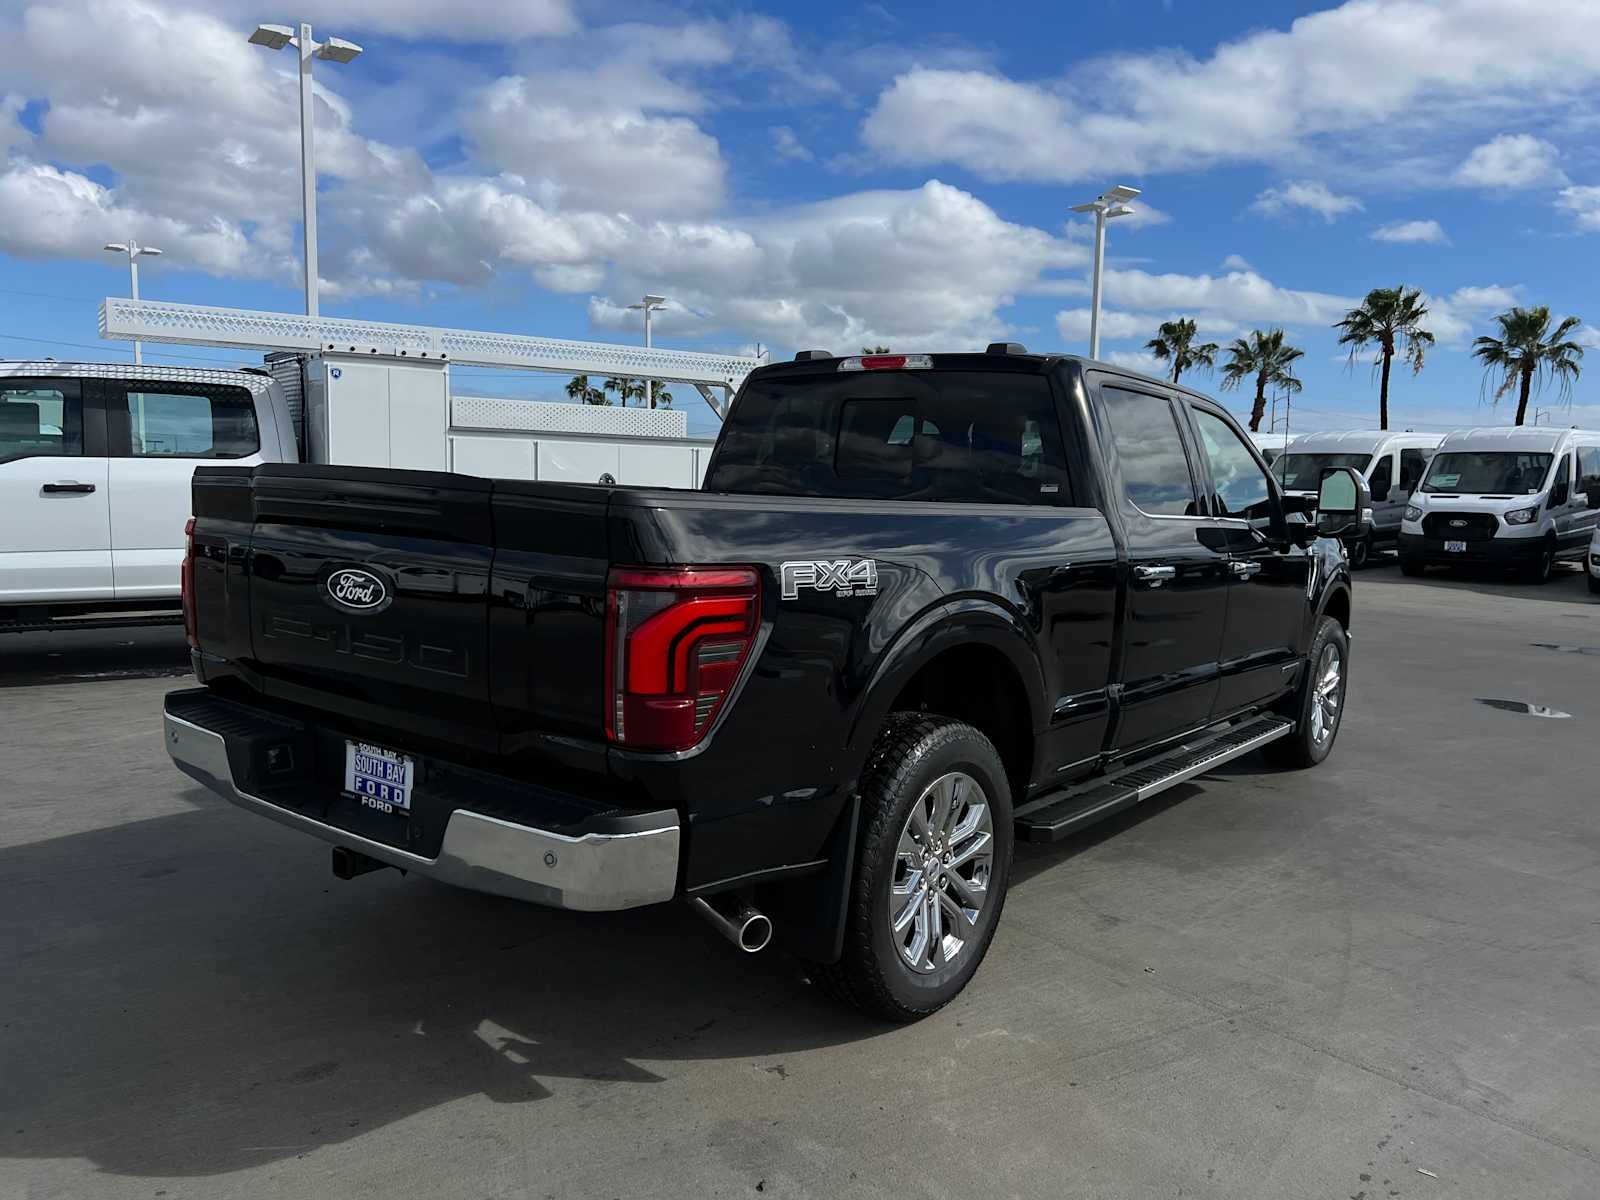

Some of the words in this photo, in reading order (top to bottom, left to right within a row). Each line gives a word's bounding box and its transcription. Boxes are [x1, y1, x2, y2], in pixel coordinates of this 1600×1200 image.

[335, 573, 374, 602] Ford
[780, 559, 878, 600] FX4
[359, 743, 382, 755] SOUTH
[355, 755, 384, 778] SOUTH
[386, 763, 405, 783] BAY
[355, 777, 403, 803] FORD
[361, 796, 393, 814] FORD
